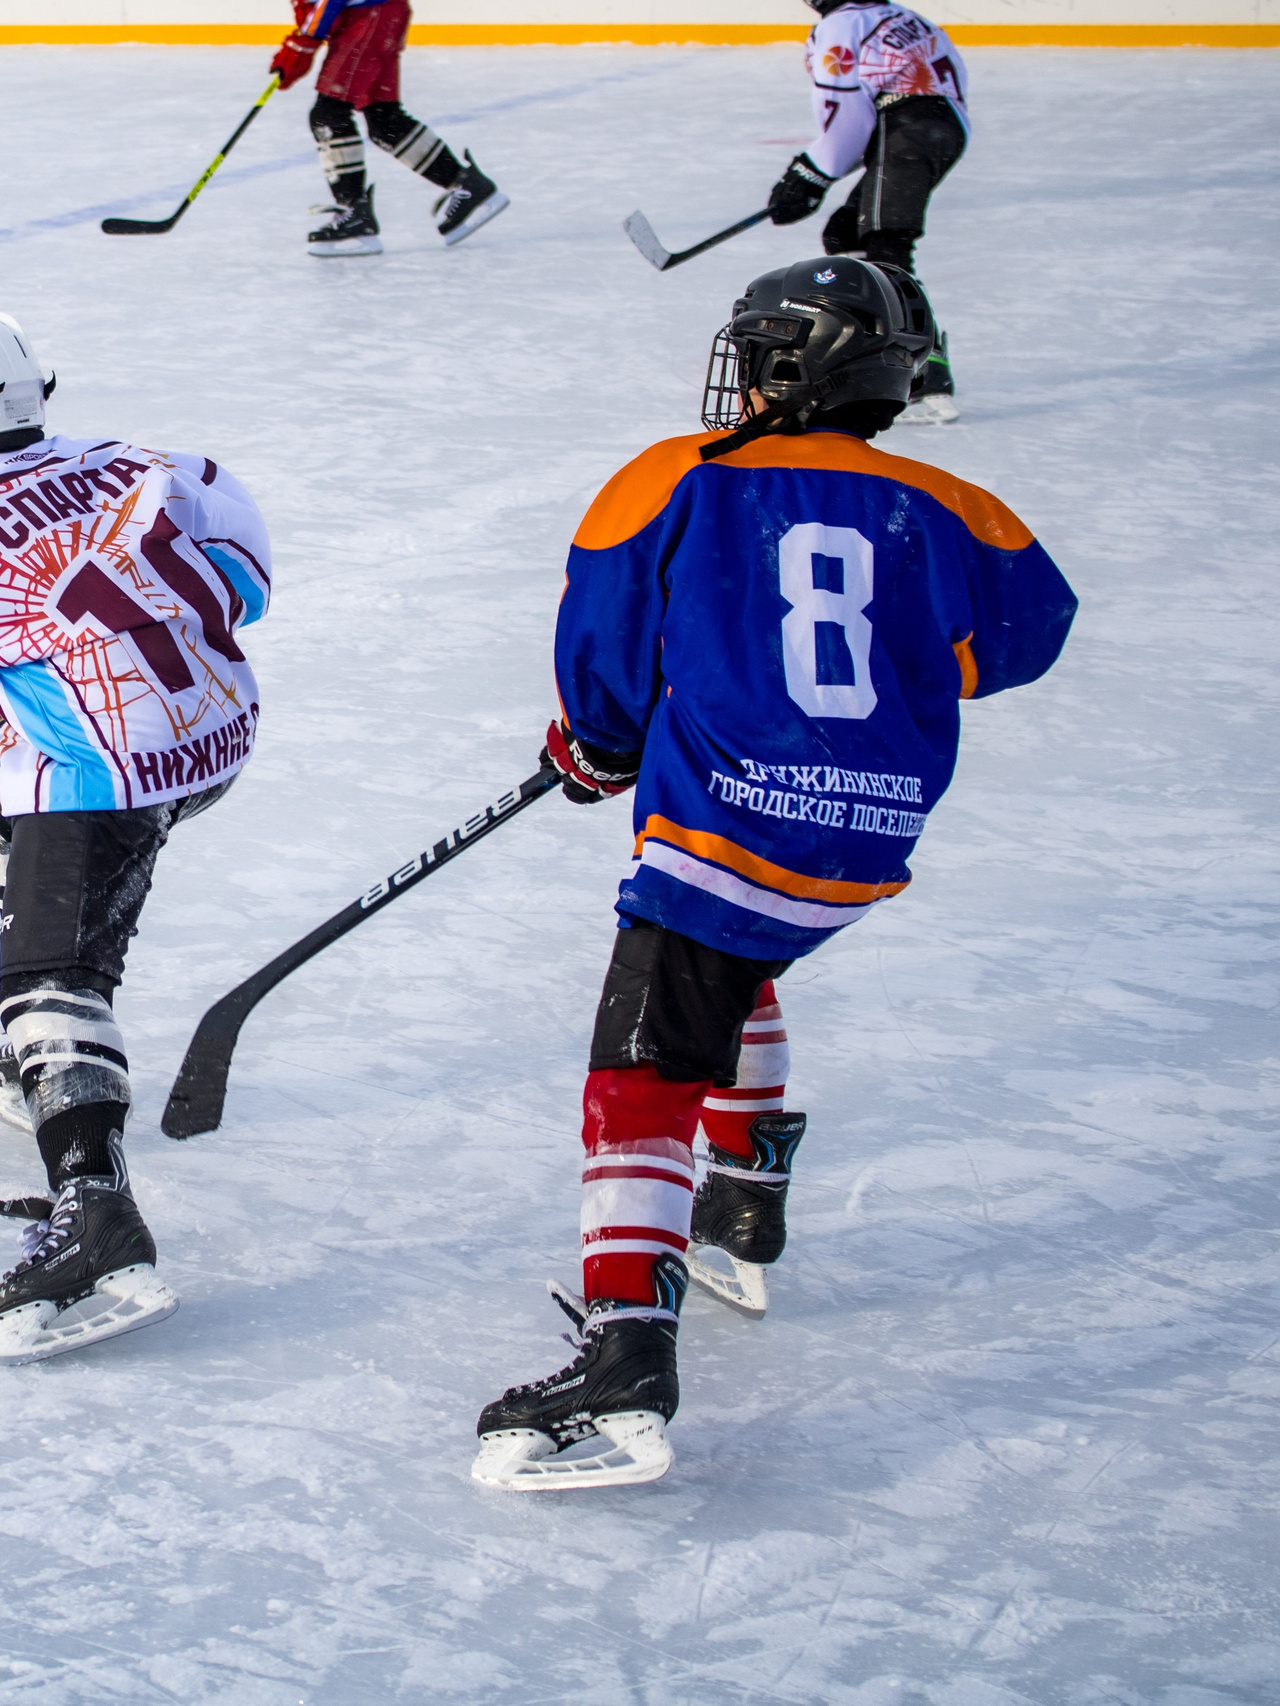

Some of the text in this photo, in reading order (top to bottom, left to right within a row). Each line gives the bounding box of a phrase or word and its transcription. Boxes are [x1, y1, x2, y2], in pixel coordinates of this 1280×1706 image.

[931, 55, 965, 102] 7
[824, 100, 840, 133] 7
[56, 507, 247, 695] 10
[779, 523, 878, 720] 8
[707, 770, 847, 828] ГОРОДСКОЕ
